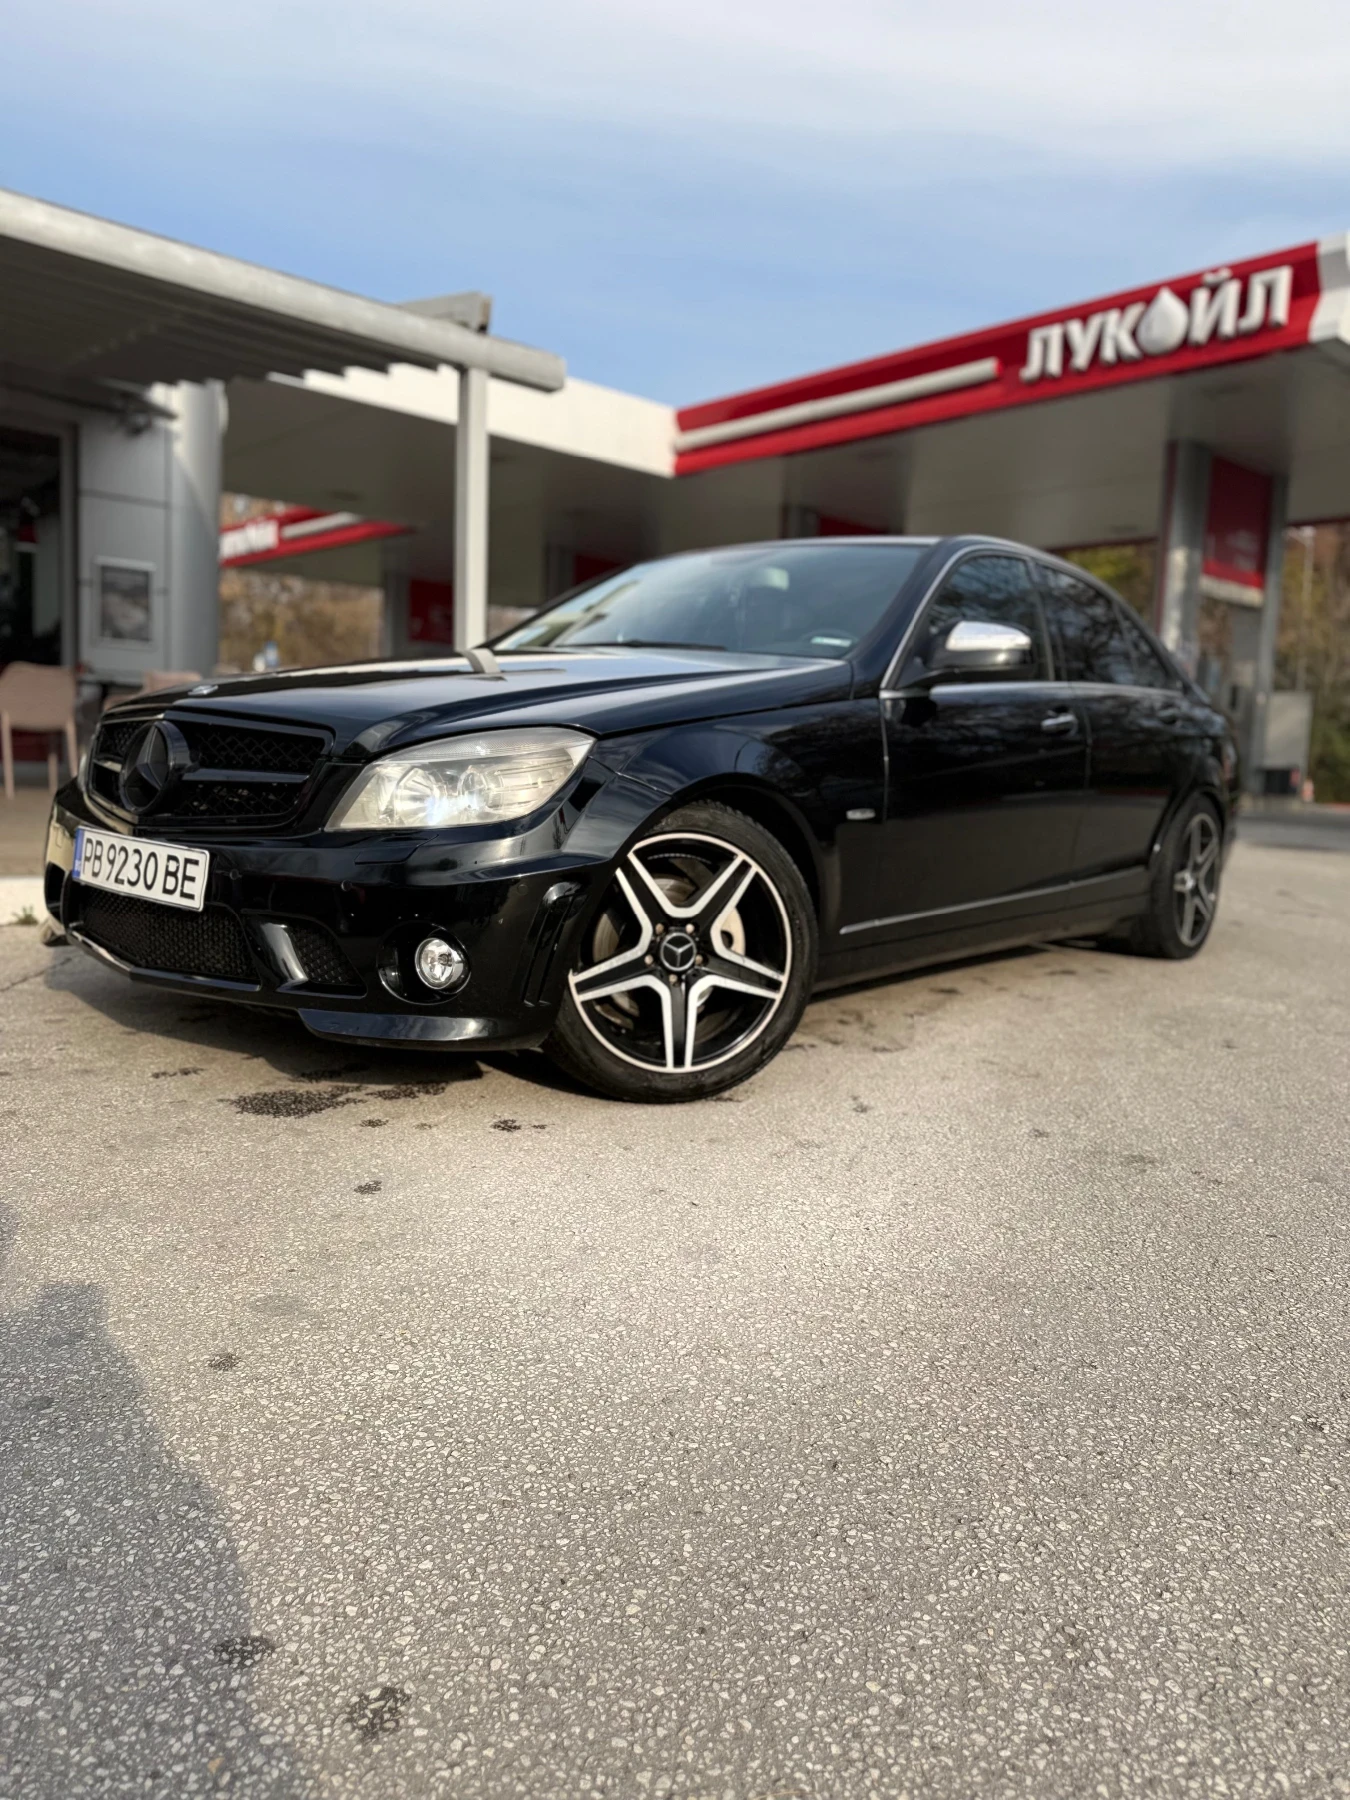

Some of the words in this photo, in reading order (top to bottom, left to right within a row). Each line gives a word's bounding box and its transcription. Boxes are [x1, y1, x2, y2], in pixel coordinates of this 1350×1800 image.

[1019, 265, 1293, 382] ЛУКОЙЛ
[83, 838, 103, 877] PB
[106, 843, 158, 891] 9230
[162, 854, 199, 900] BE
